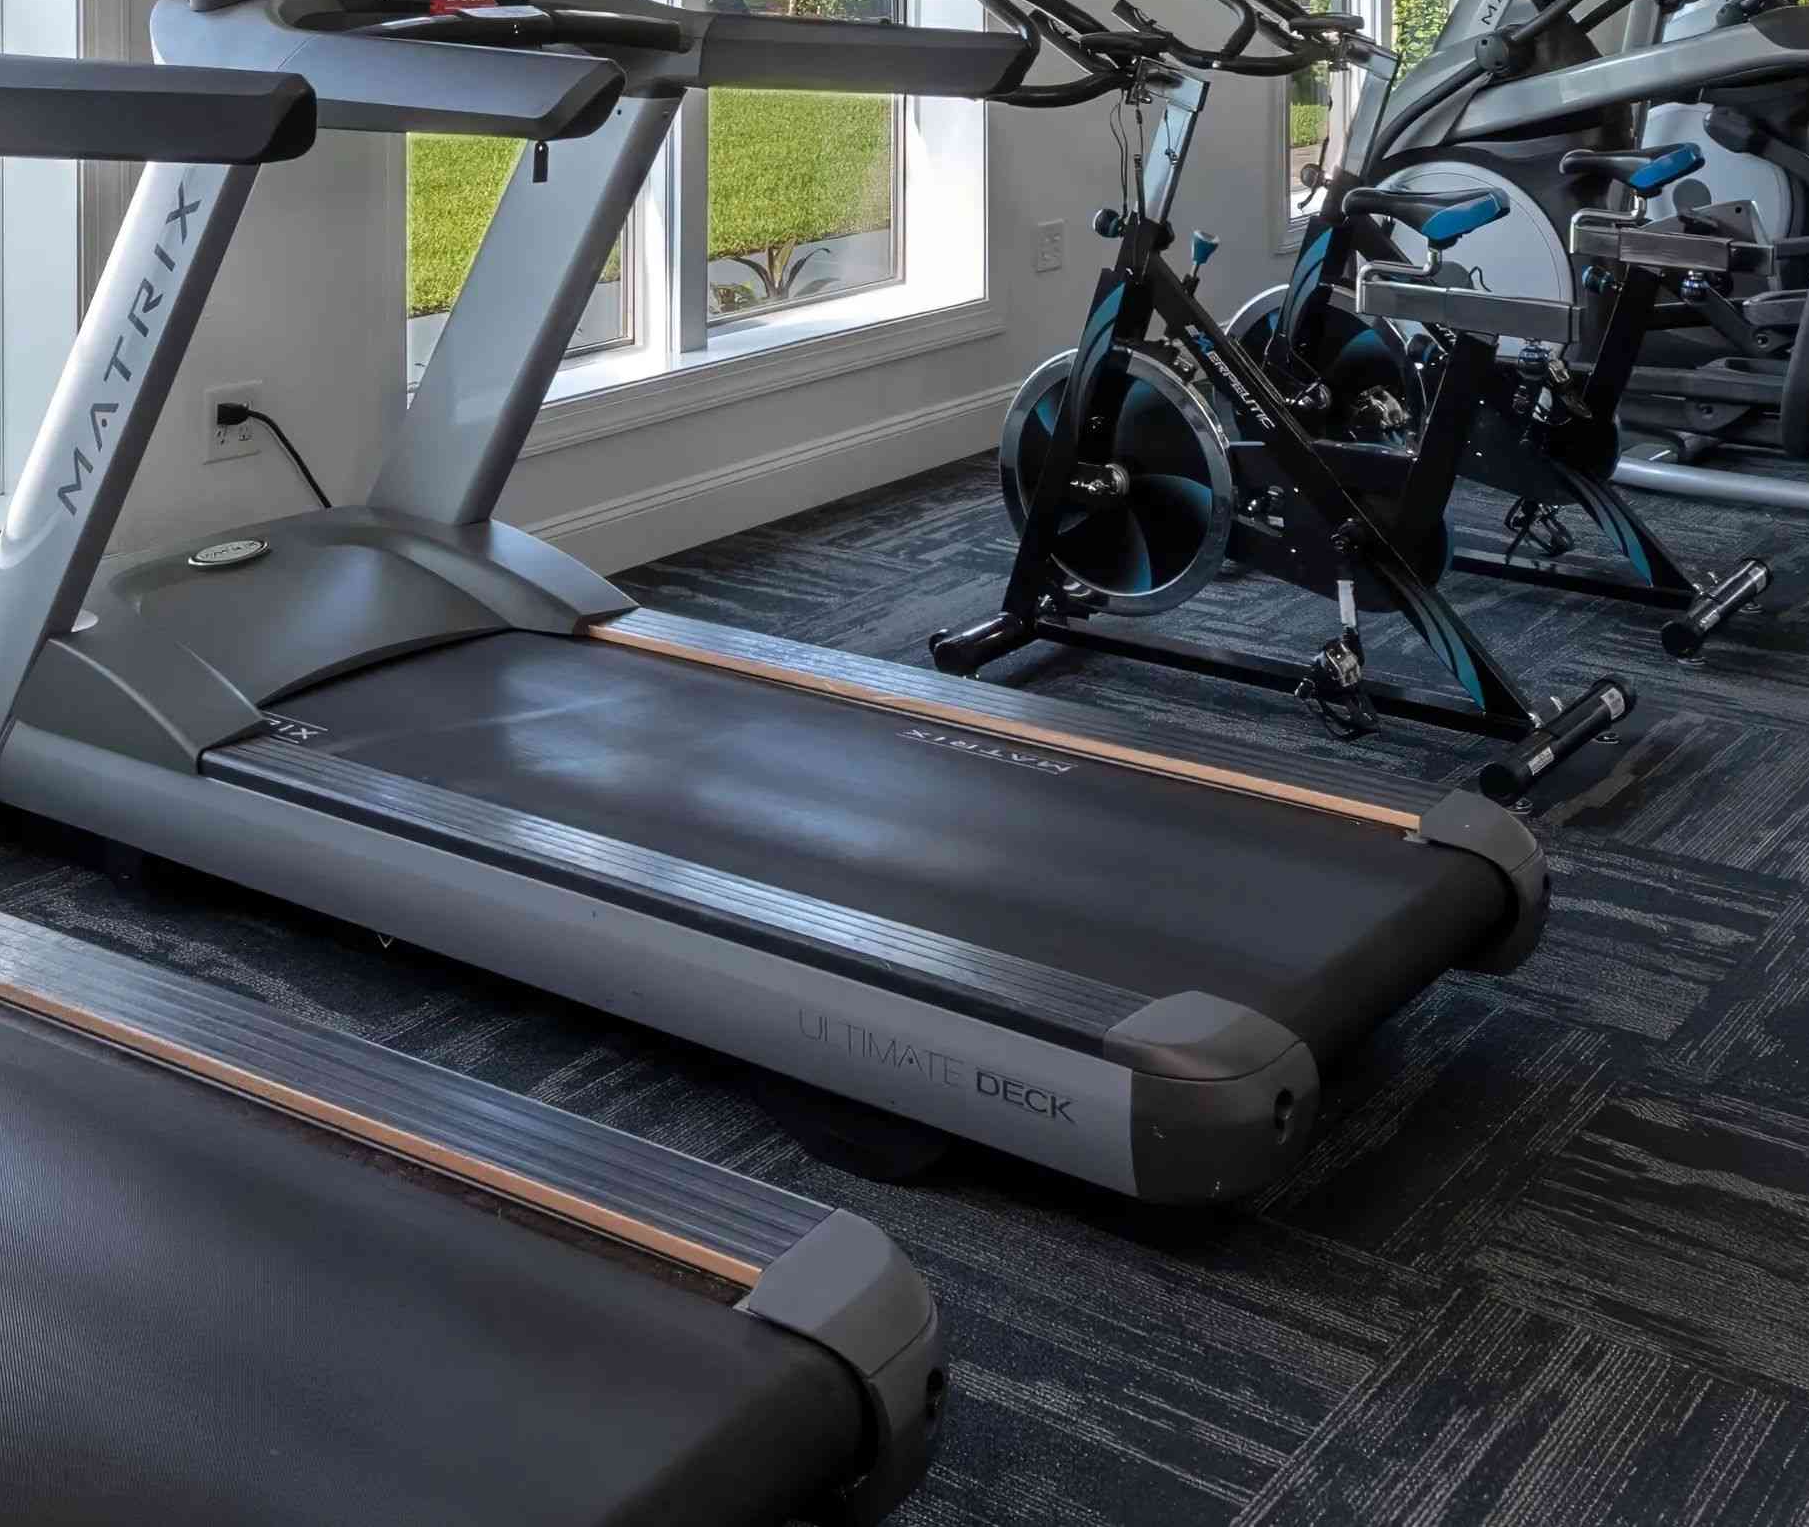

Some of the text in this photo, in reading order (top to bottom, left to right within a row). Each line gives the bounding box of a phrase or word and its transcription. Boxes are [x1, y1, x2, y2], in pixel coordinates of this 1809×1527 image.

[57, 181, 202, 516] MATRIX
[903, 728, 1078, 772] MATRIX
[798, 1008, 1077, 1124] ULTIMATE DECK
